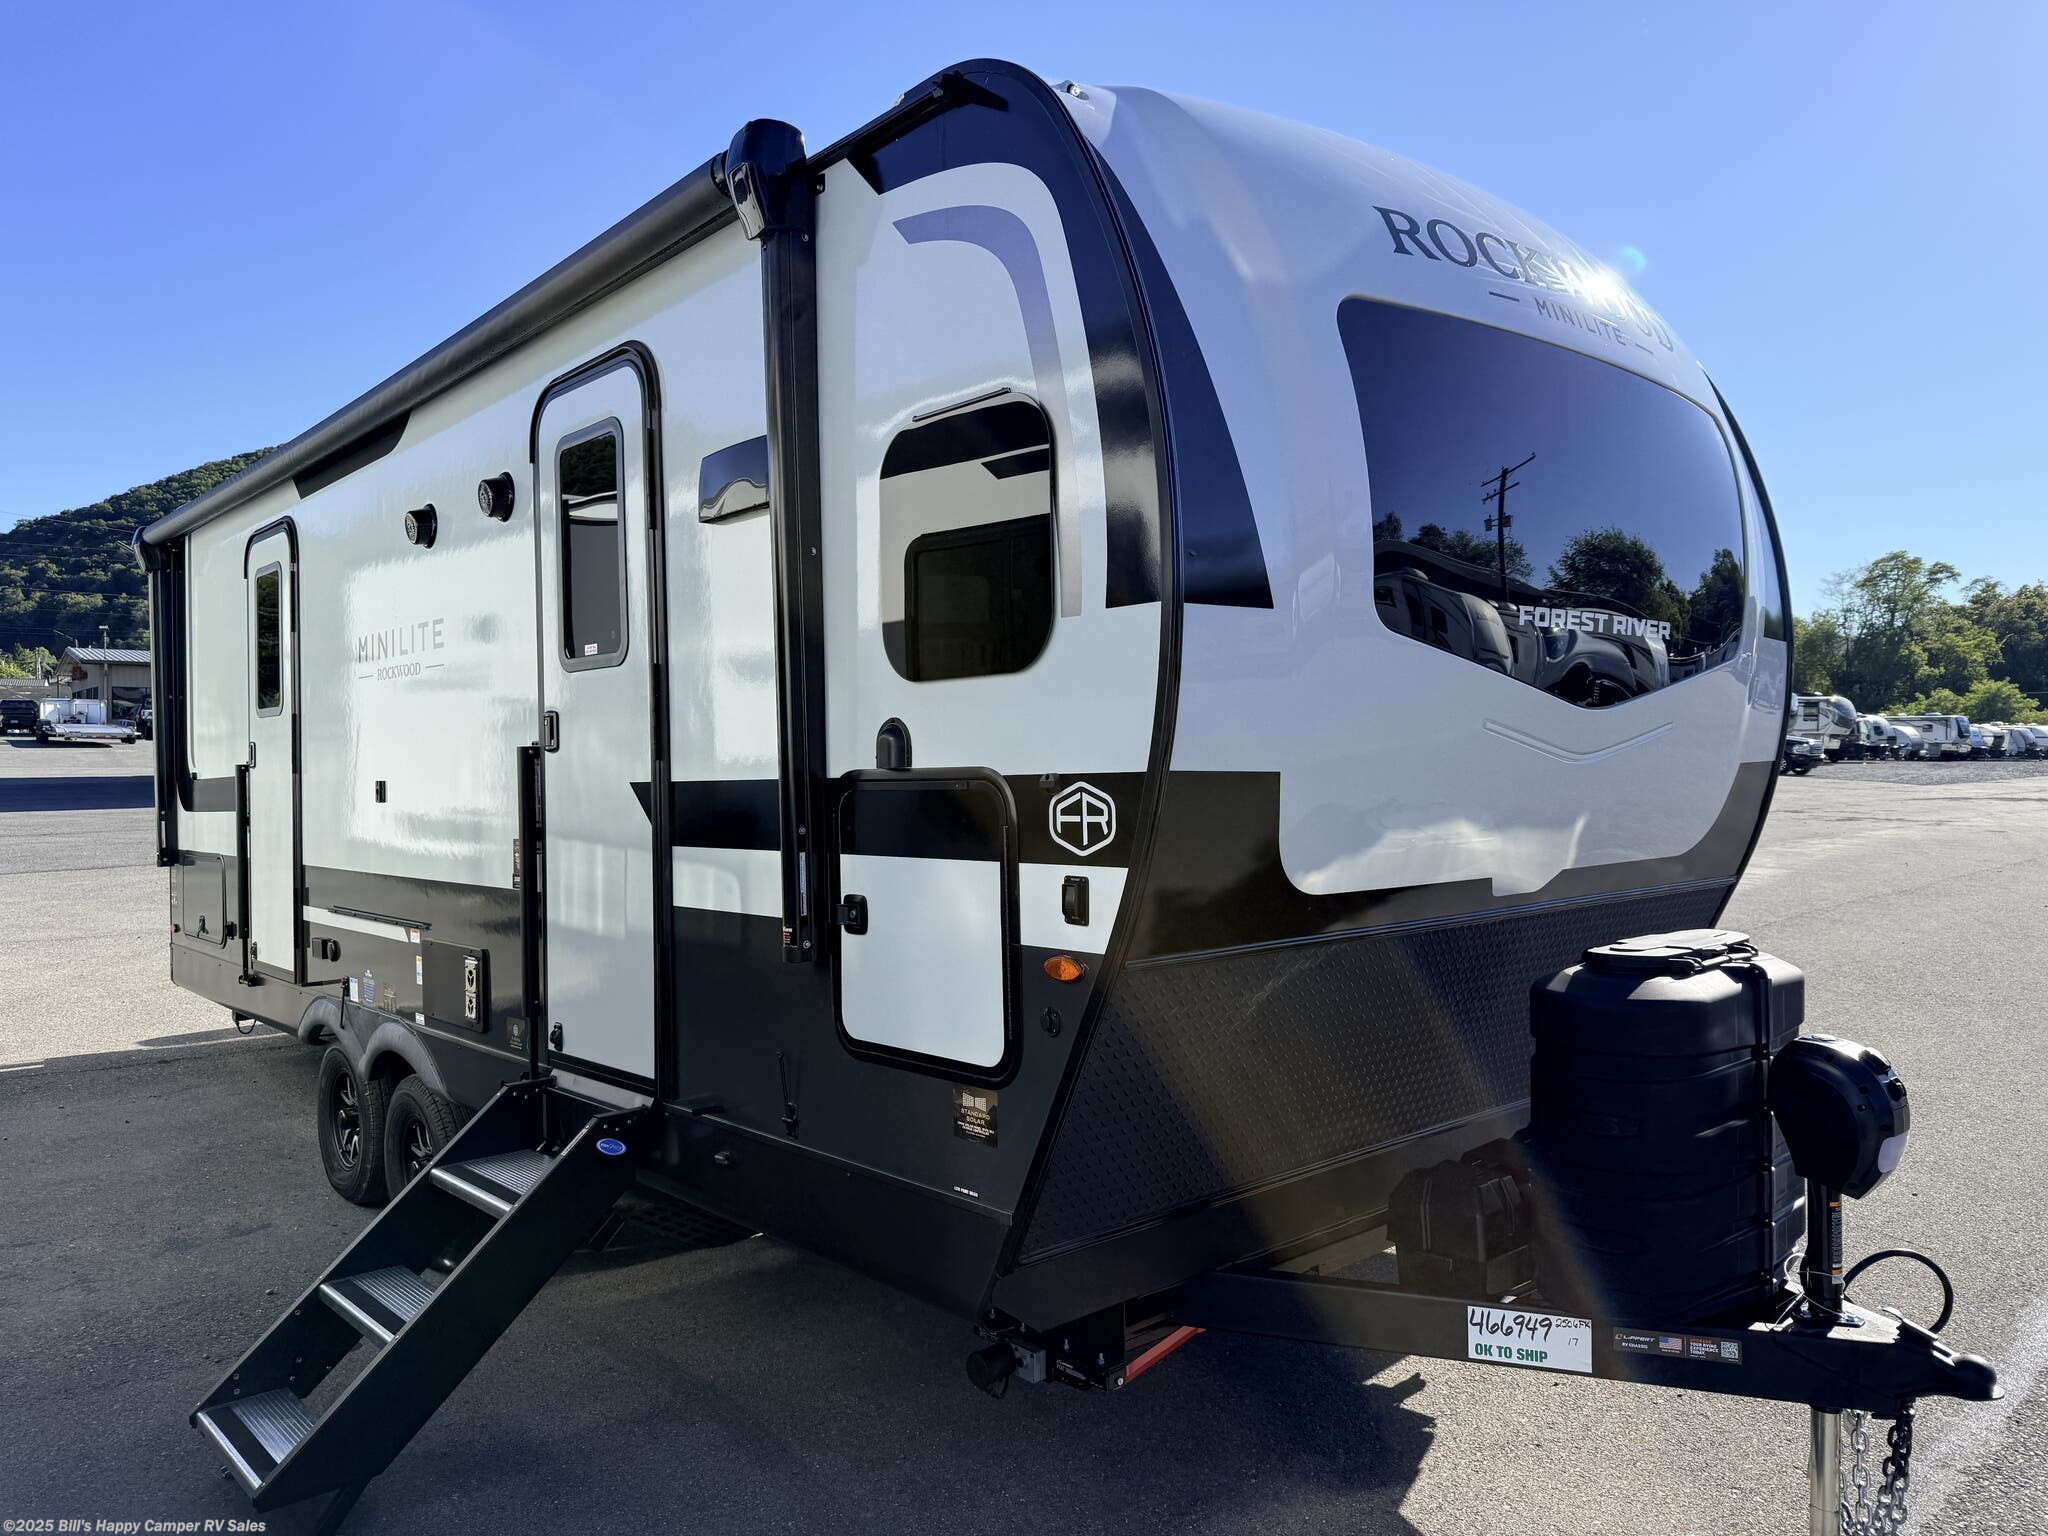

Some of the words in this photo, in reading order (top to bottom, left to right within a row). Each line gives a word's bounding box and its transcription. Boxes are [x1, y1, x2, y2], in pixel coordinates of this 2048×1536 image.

[1371, 205, 1674, 352] ROCKOD
[1534, 296, 1627, 346] MINILITE
[1518, 604, 1609, 633] FOREST
[1612, 614, 1671, 640] RIVER
[358, 617, 445, 664] MINILITE
[377, 662, 421, 681] ROCKWOOD
[960, 1107, 991, 1121] STANDARD
[966, 1115, 985, 1125] SOLAR
[1469, 1308, 1553, 1342] 466949
[1474, 1342, 1493, 1357] OK
[1496, 1345, 1513, 1359] TO
[1516, 1348, 1548, 1363] SHIP
